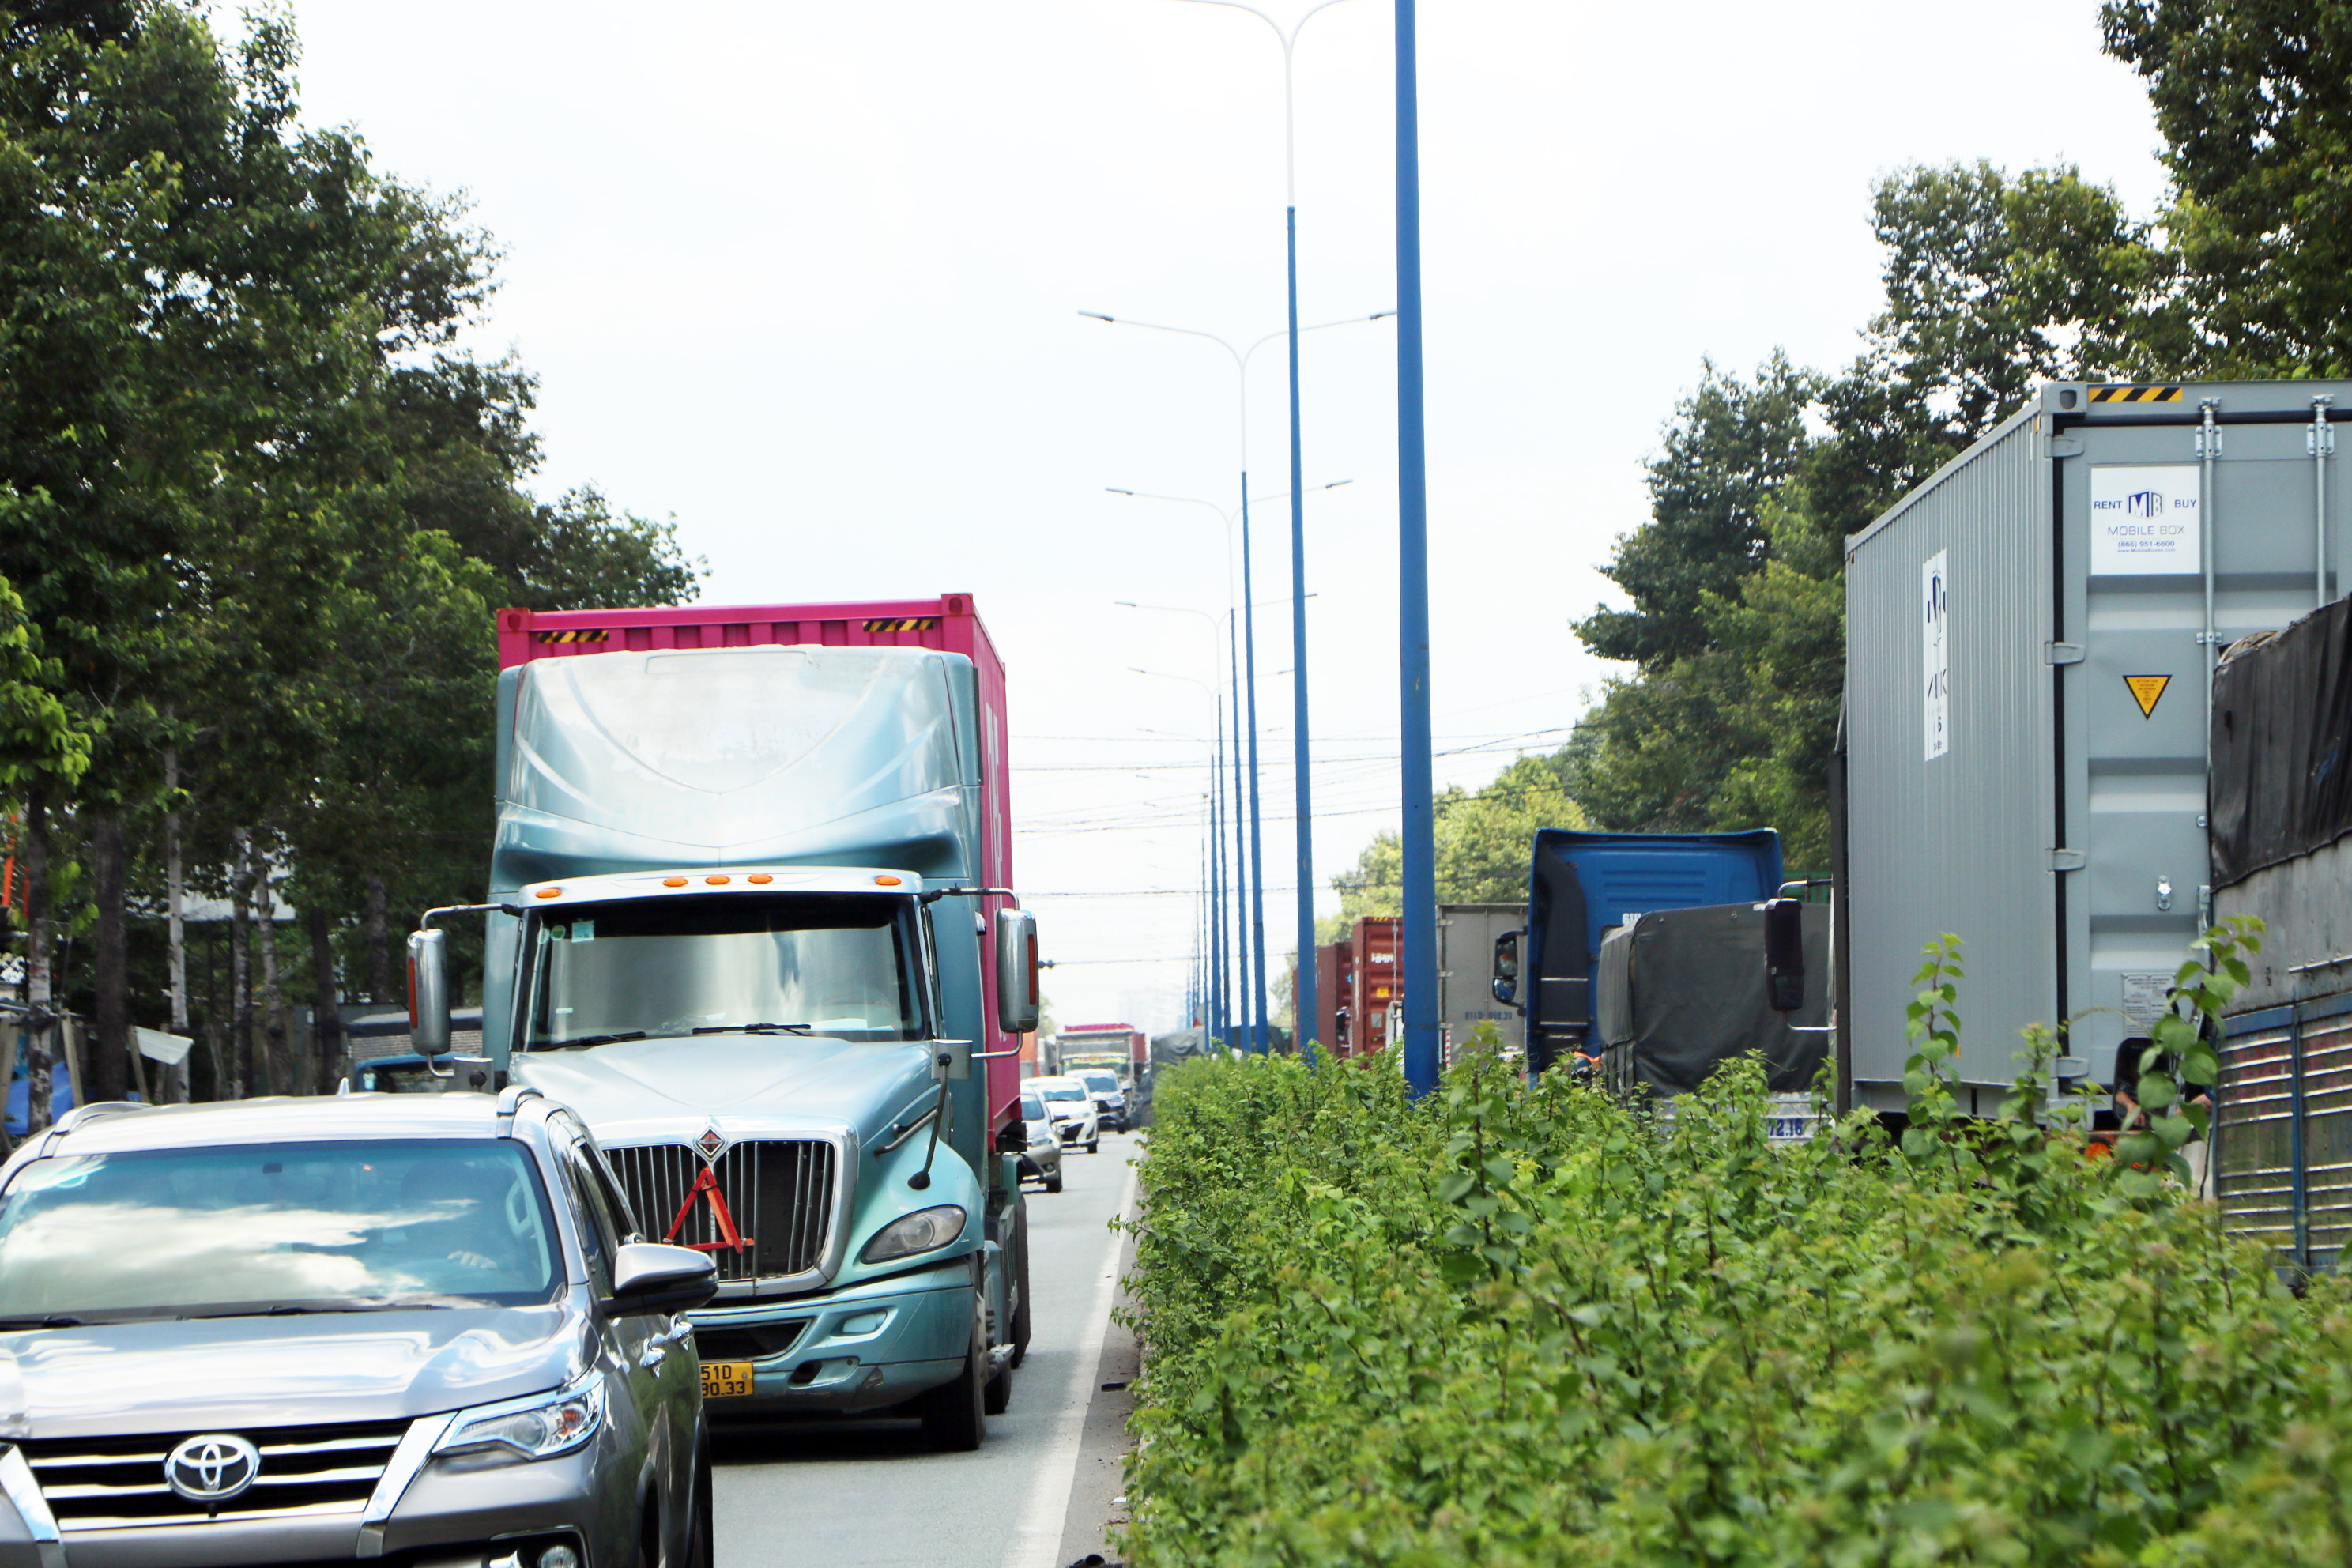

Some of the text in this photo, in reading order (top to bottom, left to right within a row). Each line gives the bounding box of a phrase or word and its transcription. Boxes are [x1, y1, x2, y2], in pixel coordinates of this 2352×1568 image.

[2094, 500, 2123, 510] RENT
[2174, 499, 2198, 508] BUY
[2107, 525, 2186, 536] MOBILE BOX
[701, 1365, 732, 1380] 51D
